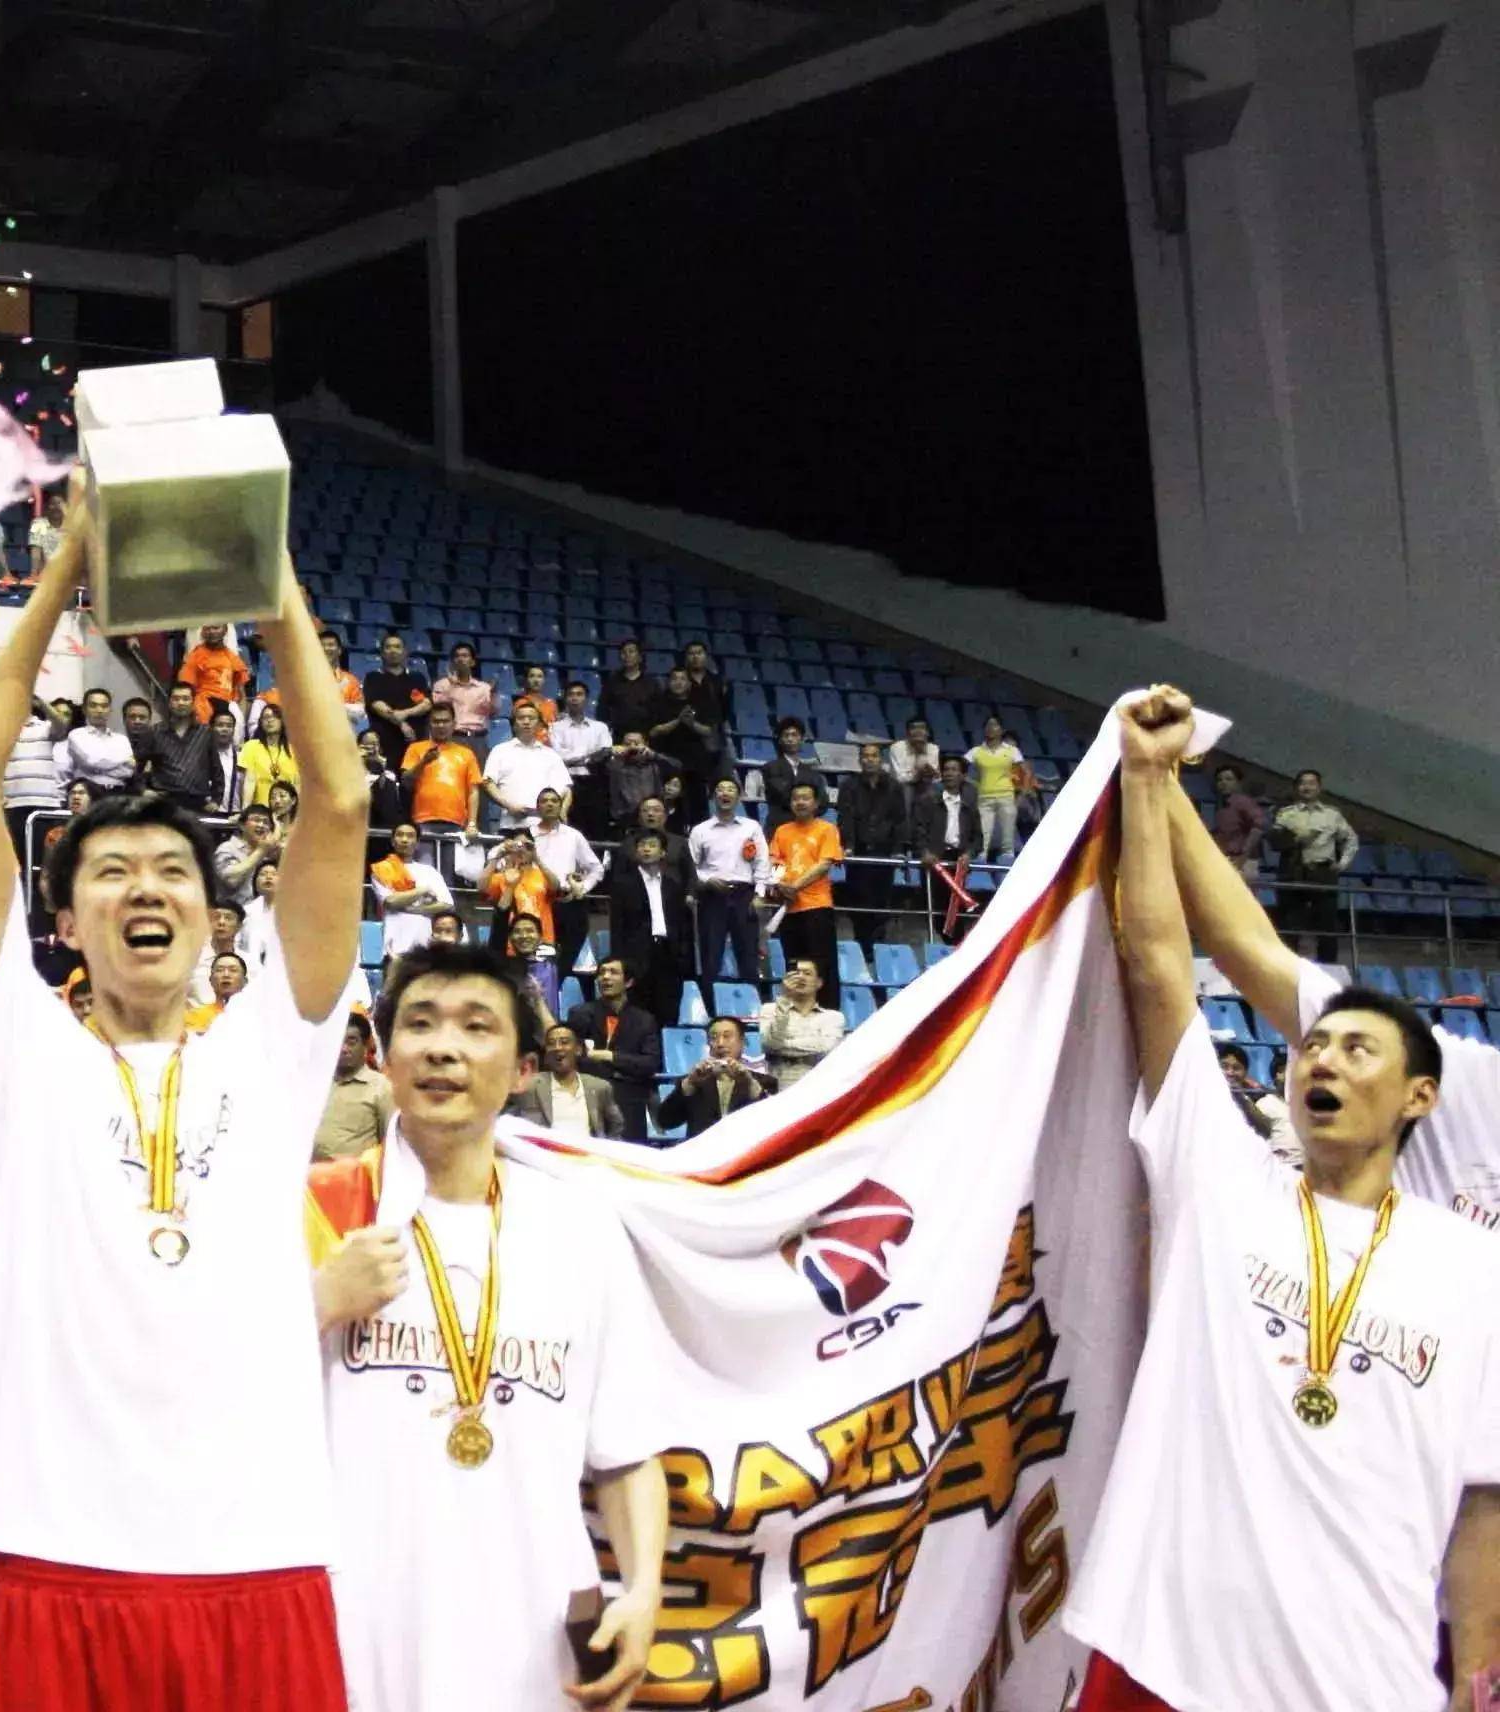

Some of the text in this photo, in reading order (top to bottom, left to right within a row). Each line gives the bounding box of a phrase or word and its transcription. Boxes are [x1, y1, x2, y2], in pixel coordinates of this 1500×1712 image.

[343, 1317, 570, 1402] CHAMONS
[816, 1302, 924, 1362] CBA
[1242, 1253, 1441, 1389] HAMIONS
